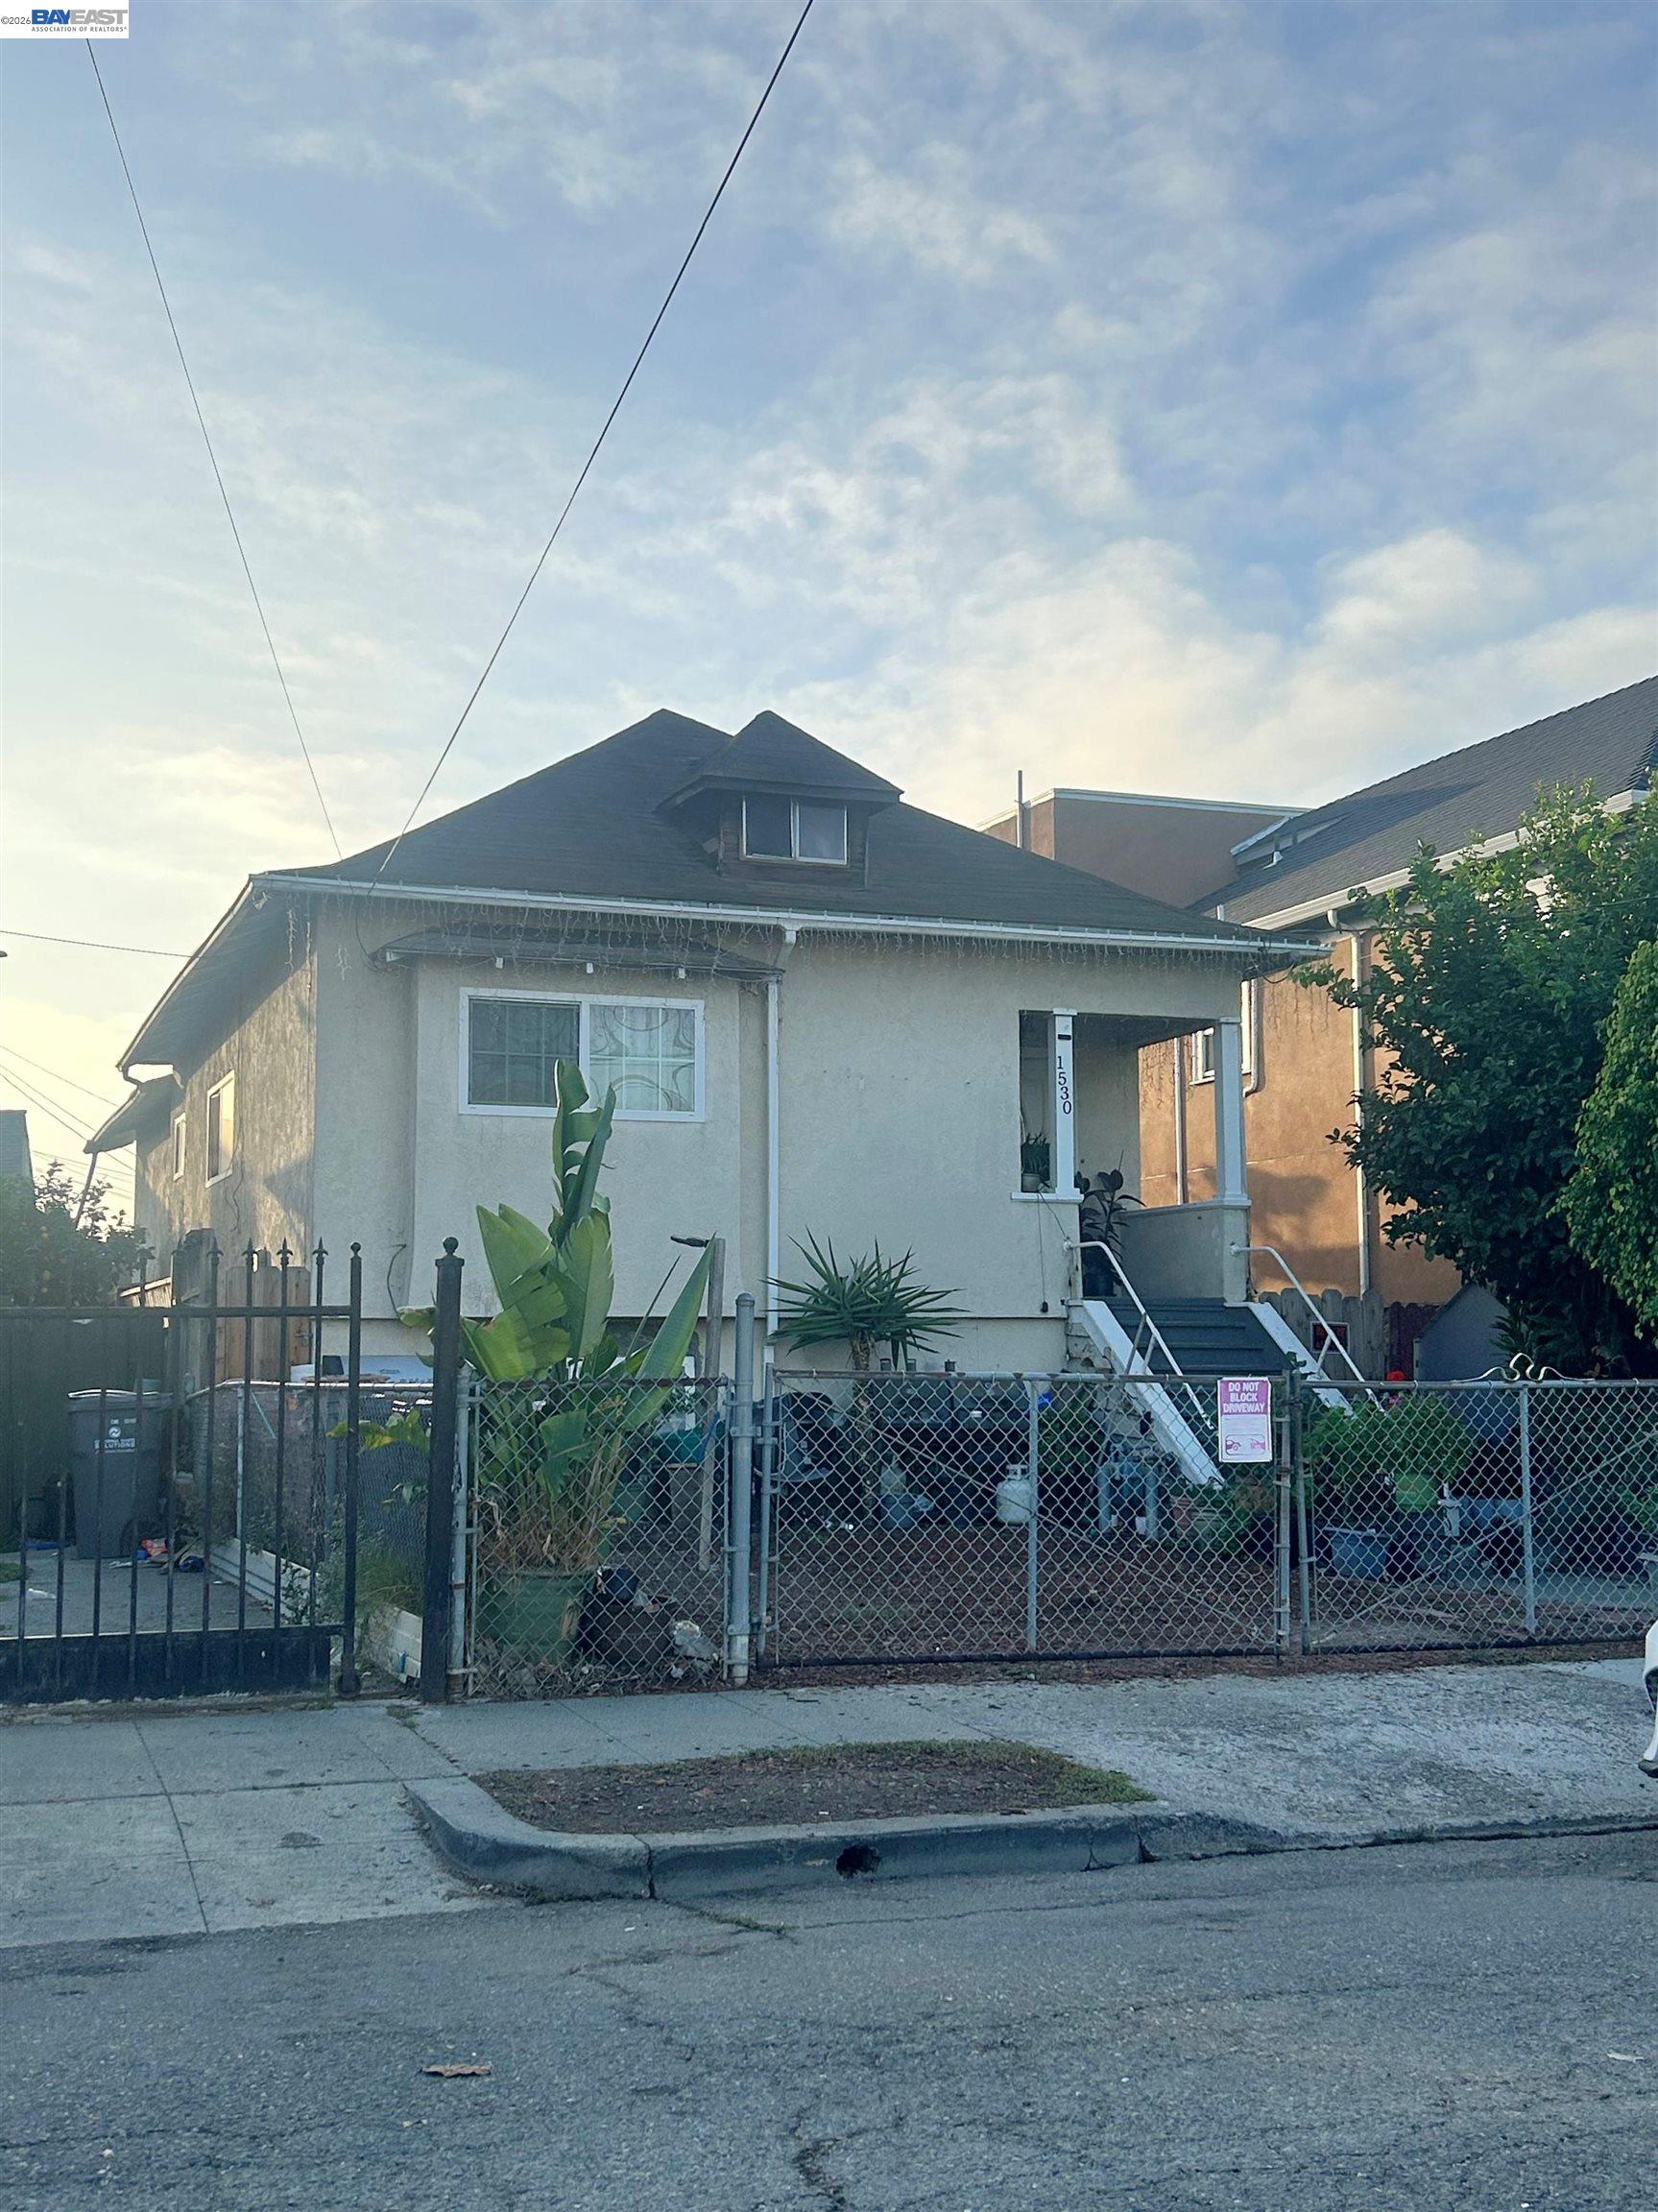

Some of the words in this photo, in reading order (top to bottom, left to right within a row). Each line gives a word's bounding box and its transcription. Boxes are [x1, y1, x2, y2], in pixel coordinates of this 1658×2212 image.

[1057, 1056, 1071, 1115] 1530
[1229, 1382, 1240, 1391] DO
[1242, 1382, 1259, 1391] NOT
[1230, 1393, 1258, 1402] BLOCK
[1223, 1404, 1265, 1412] DRIVEWAY
